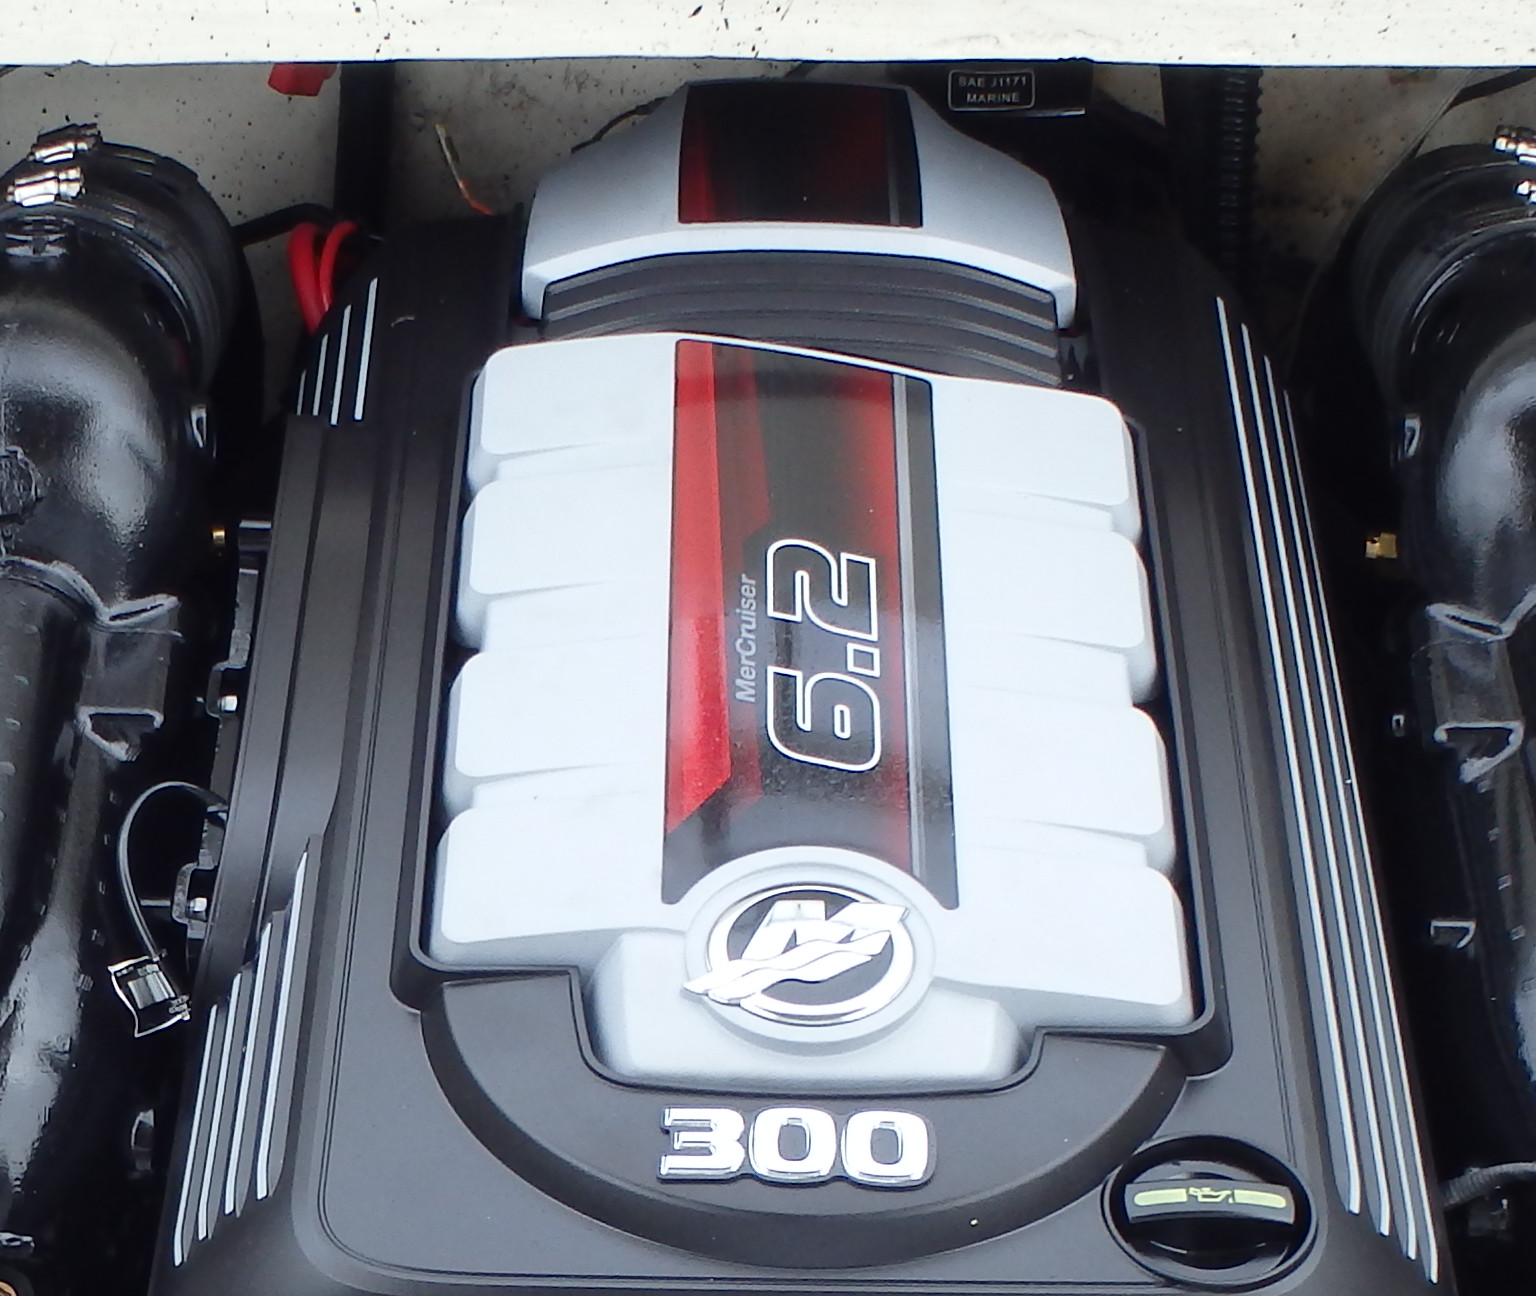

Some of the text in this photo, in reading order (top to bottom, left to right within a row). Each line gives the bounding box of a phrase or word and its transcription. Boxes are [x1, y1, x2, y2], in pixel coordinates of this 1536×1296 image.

[967, 92, 1019, 103] MARINE
[735, 573, 757, 704] MerCruiser
[766, 538, 882, 772] 6.2
[658, 1104, 938, 1188] 300
